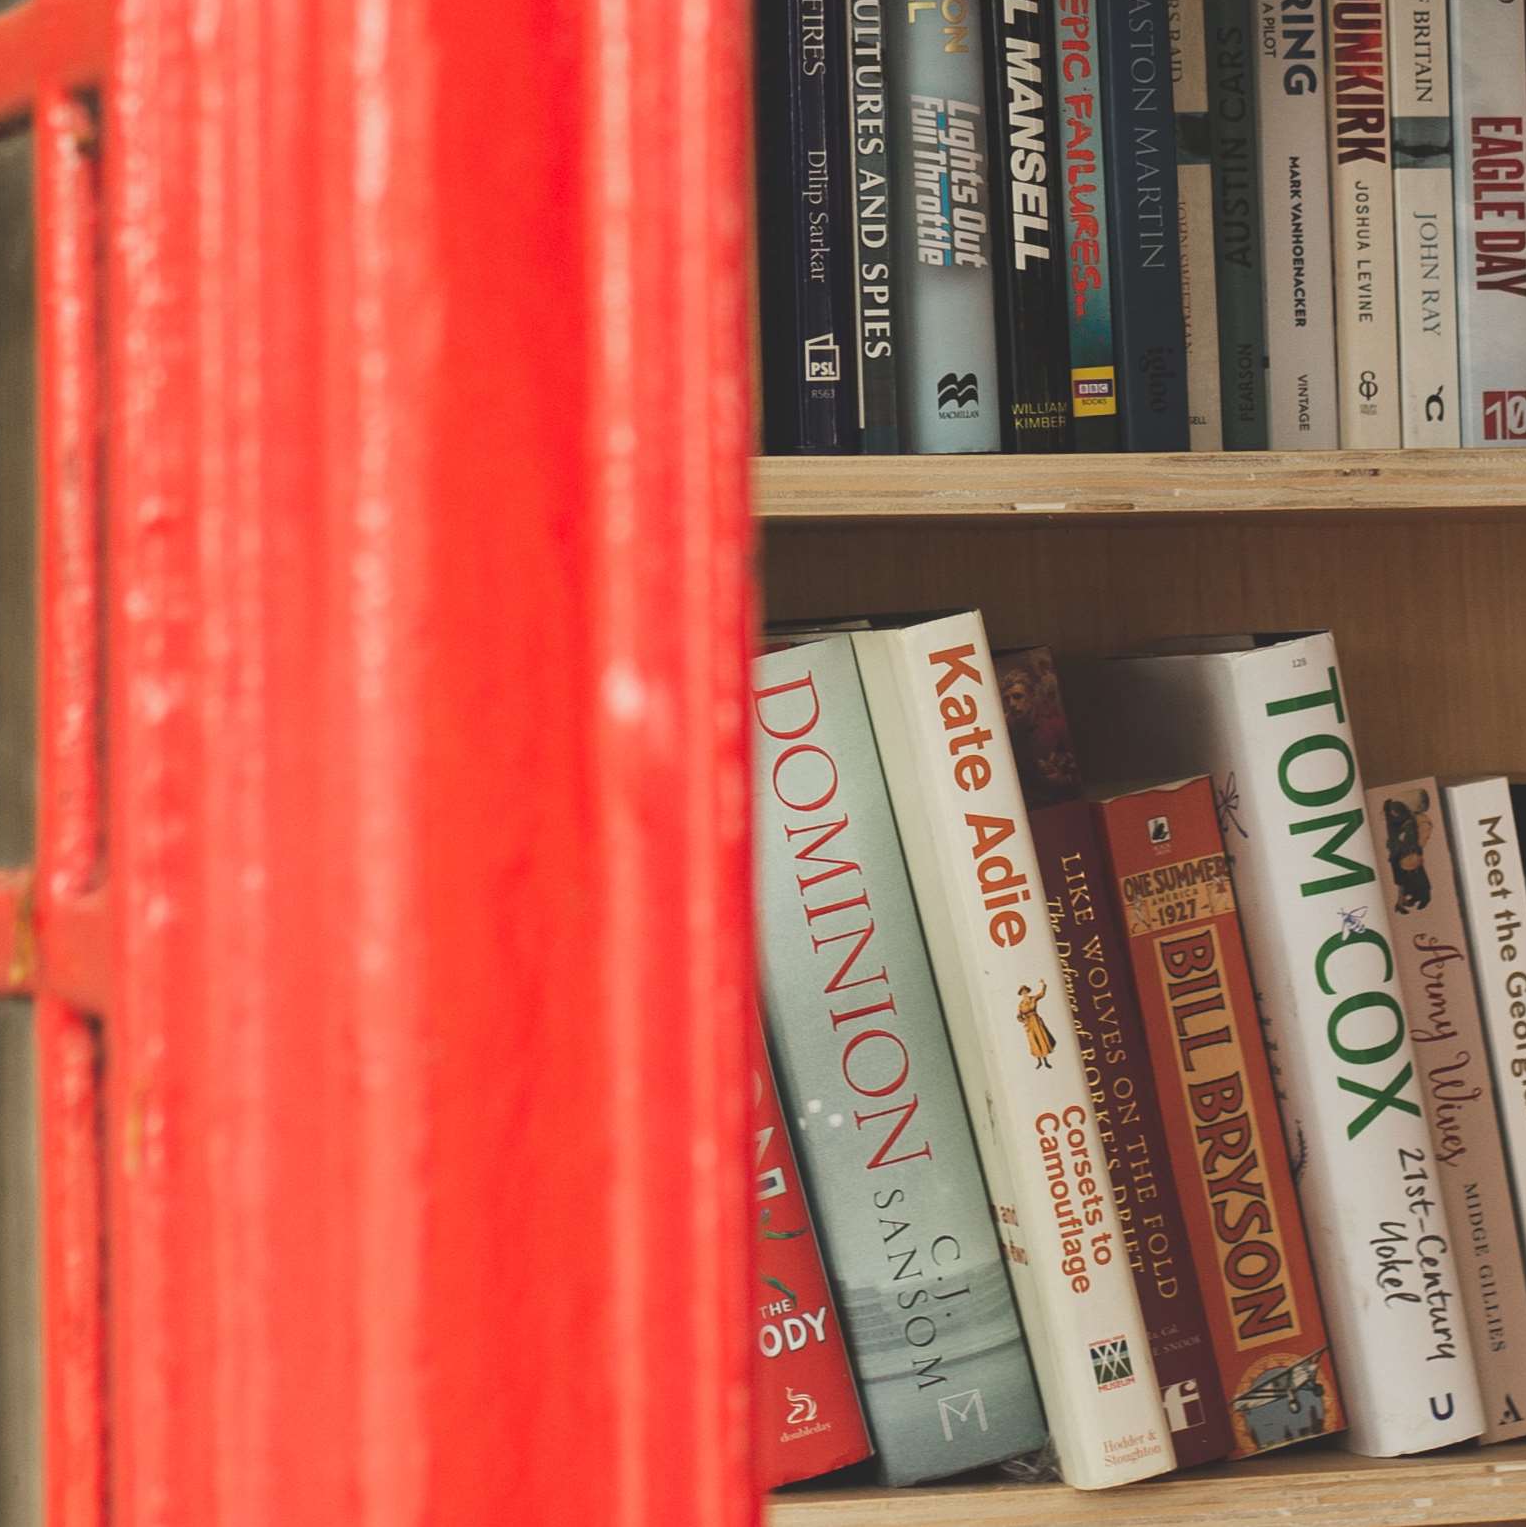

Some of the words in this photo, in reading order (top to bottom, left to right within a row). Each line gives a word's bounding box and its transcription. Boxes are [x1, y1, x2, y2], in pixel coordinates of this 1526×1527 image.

[1262, 3, 1274, 14] A
[1263, 17, 1277, 58] PILOT
[1217, 27, 1247, 122] CARS
[1412, 11, 1435, 103] BRITAIN
[910, 94, 946, 145] Full
[945, 99, 985, 204] Lights
[1005, 37, 1051, 271] MANSELL
[802, 151, 829, 205] Dilip
[857, 169, 888, 249] AND
[912, 149, 952, 266] Throttle
[1134, 126, 1168, 269] MARTIN
[1220, 137, 1253, 269] AUSTIN
[1288, 156, 1304, 201] MARK
[1354, 180, 1371, 251] JOSHUA
[808, 211, 832, 282] Sarkar
[953, 211, 990, 269] Out
[1289, 202, 1306, 328] VANHOENACKER
[1413, 210, 1440, 280] JOHN
[861, 263, 892, 359] SPIES
[1356, 259, 1373, 323] LEVINE
[1420, 289, 1442, 337] RAY
[811, 362, 835, 376] PSL
[1079, 384, 1109, 394] BBC
[1236, 343, 1256, 422] PEARSON
[1297, 374, 1312, 433] VINTAGE
[1011, 402, 1068, 416] WILLIAM
[1014, 416, 1066, 429] KIMBER
[928, 643, 994, 793] Kate
[964, 813, 1032, 949] Adie
[1265, 667, 1376, 897] TOM
[1123, 873, 1153, 902] ONE
[1154, 856, 1229, 892] SUMMER
[1153, 888, 1198, 905] AMERICA
[1479, 816, 1511, 899] Meet
[753, 670, 932, 1170] DOMINION
[1047, 897, 1065, 937] The
[1494, 910, 1521, 963] the
[1160, 929, 1233, 1072] BILL
[1410, 933, 1465, 1043] Army
[1314, 928, 1422, 1141] COX
[1060, 852, 1095, 926] LIKE
[1082, 933, 1127, 1065] WOLVES
[1112, 1077, 1140, 1125] ON
[1127, 1134, 1158, 1203] THE
[1143, 1214, 1178, 1299] FOLD
[1428, 1050, 1482, 1167] Wives
[1035, 1112, 1091, 1295] Camouflage
[1061, 1105, 1104, 1227] Corsets
[1090, 1232, 1113, 1266] to
[1188, 1072, 1294, 1340] BRYSON
[873, 1188, 948, 1391] SANSOM
[1370, 1221, 1422, 1309] Yokel
[1398, 1148, 1457, 1362] 21st-Century
[1463, 1181, 1491, 1257] MIDGE
[1479, 1264, 1508, 1353] GILLIES
[758, 1307, 826, 1358] ODY
[759, 1299, 792, 1319] THE
[780, 1423, 833, 1443] doubleday
[1104, 1434, 1144, 1453] Hodder
[1148, 1430, 1157, 1441] &
[1104, 1445, 1162, 1467] Stoughton
